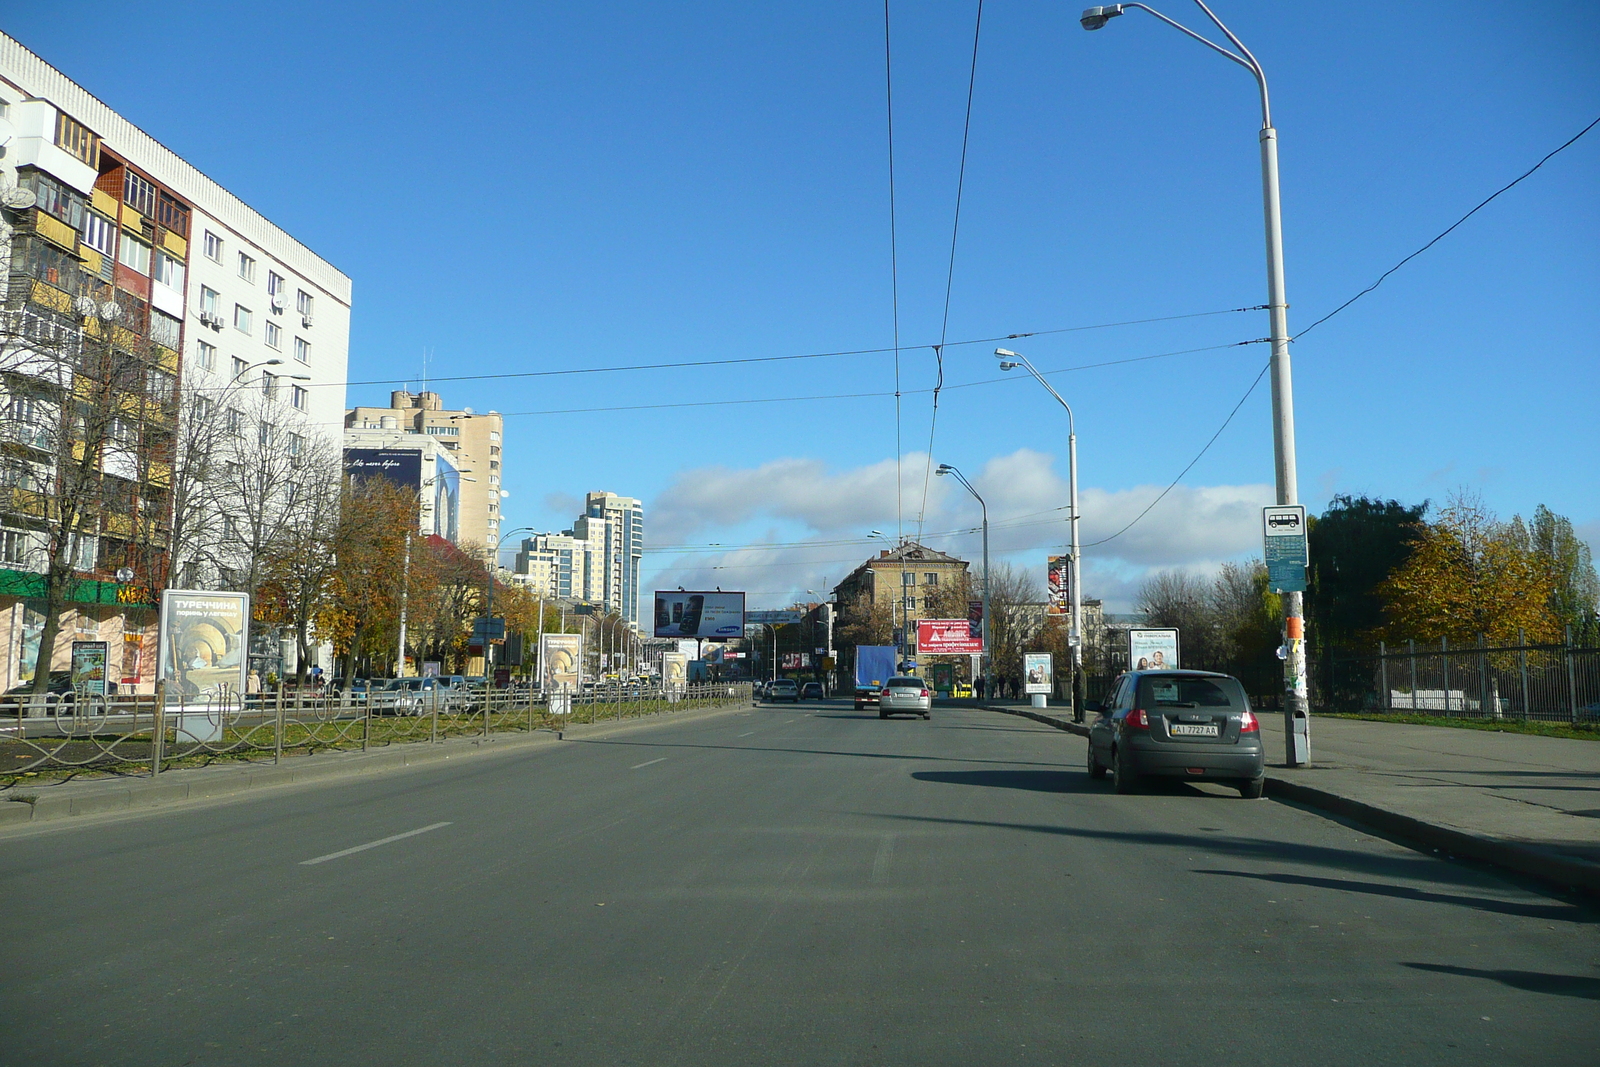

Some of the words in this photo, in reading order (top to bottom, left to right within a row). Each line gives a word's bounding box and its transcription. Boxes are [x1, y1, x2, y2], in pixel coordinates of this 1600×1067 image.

[382, 459, 400, 470] before
[174, 600, 238, 610] ТУРЕЧЧИНА
[1187, 726, 1205, 734] 7727
[1205, 727, 1218, 735] AA
